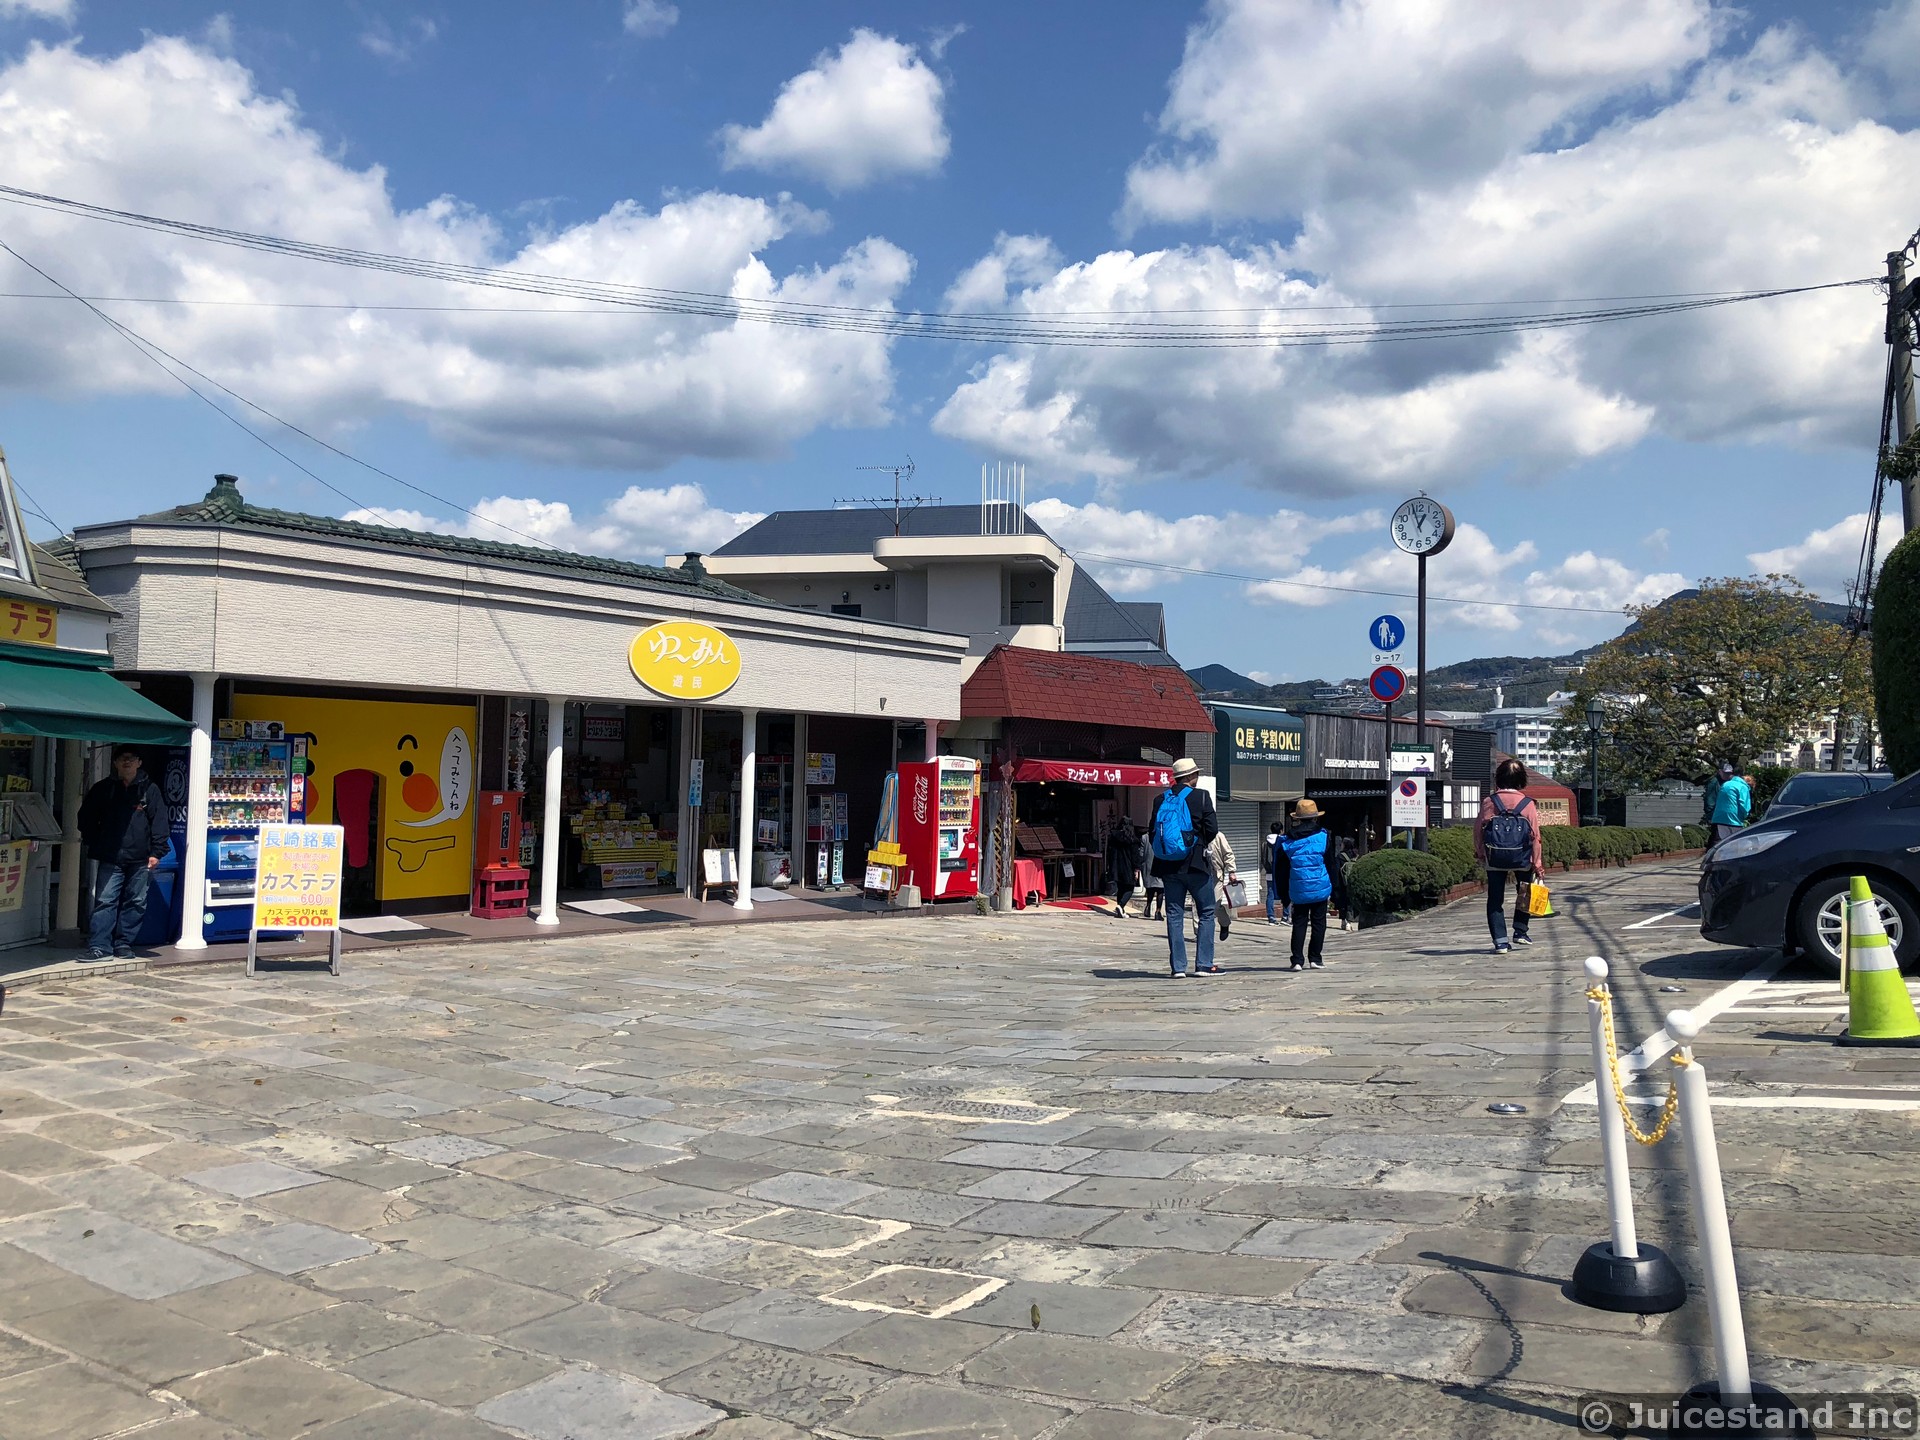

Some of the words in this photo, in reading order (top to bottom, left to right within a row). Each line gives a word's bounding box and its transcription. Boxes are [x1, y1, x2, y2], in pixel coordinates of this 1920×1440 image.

[1399, 514, 1408, 523] 10
[1433, 511, 1439, 519] 2
[1398, 524, 1404, 532] 9
[1435, 520, 1441, 528] 3
[1401, 532, 1407, 540] 8
[1416, 540, 1422, 548] 6
[1425, 537, 1431, 545] 5
[1067, 768, 1099, 781] アンティーク
[914, 774, 929, 825] Coca-Cola
[265, 831, 337, 848] 長崎銘菓
[261, 872, 336, 891] カステラ
